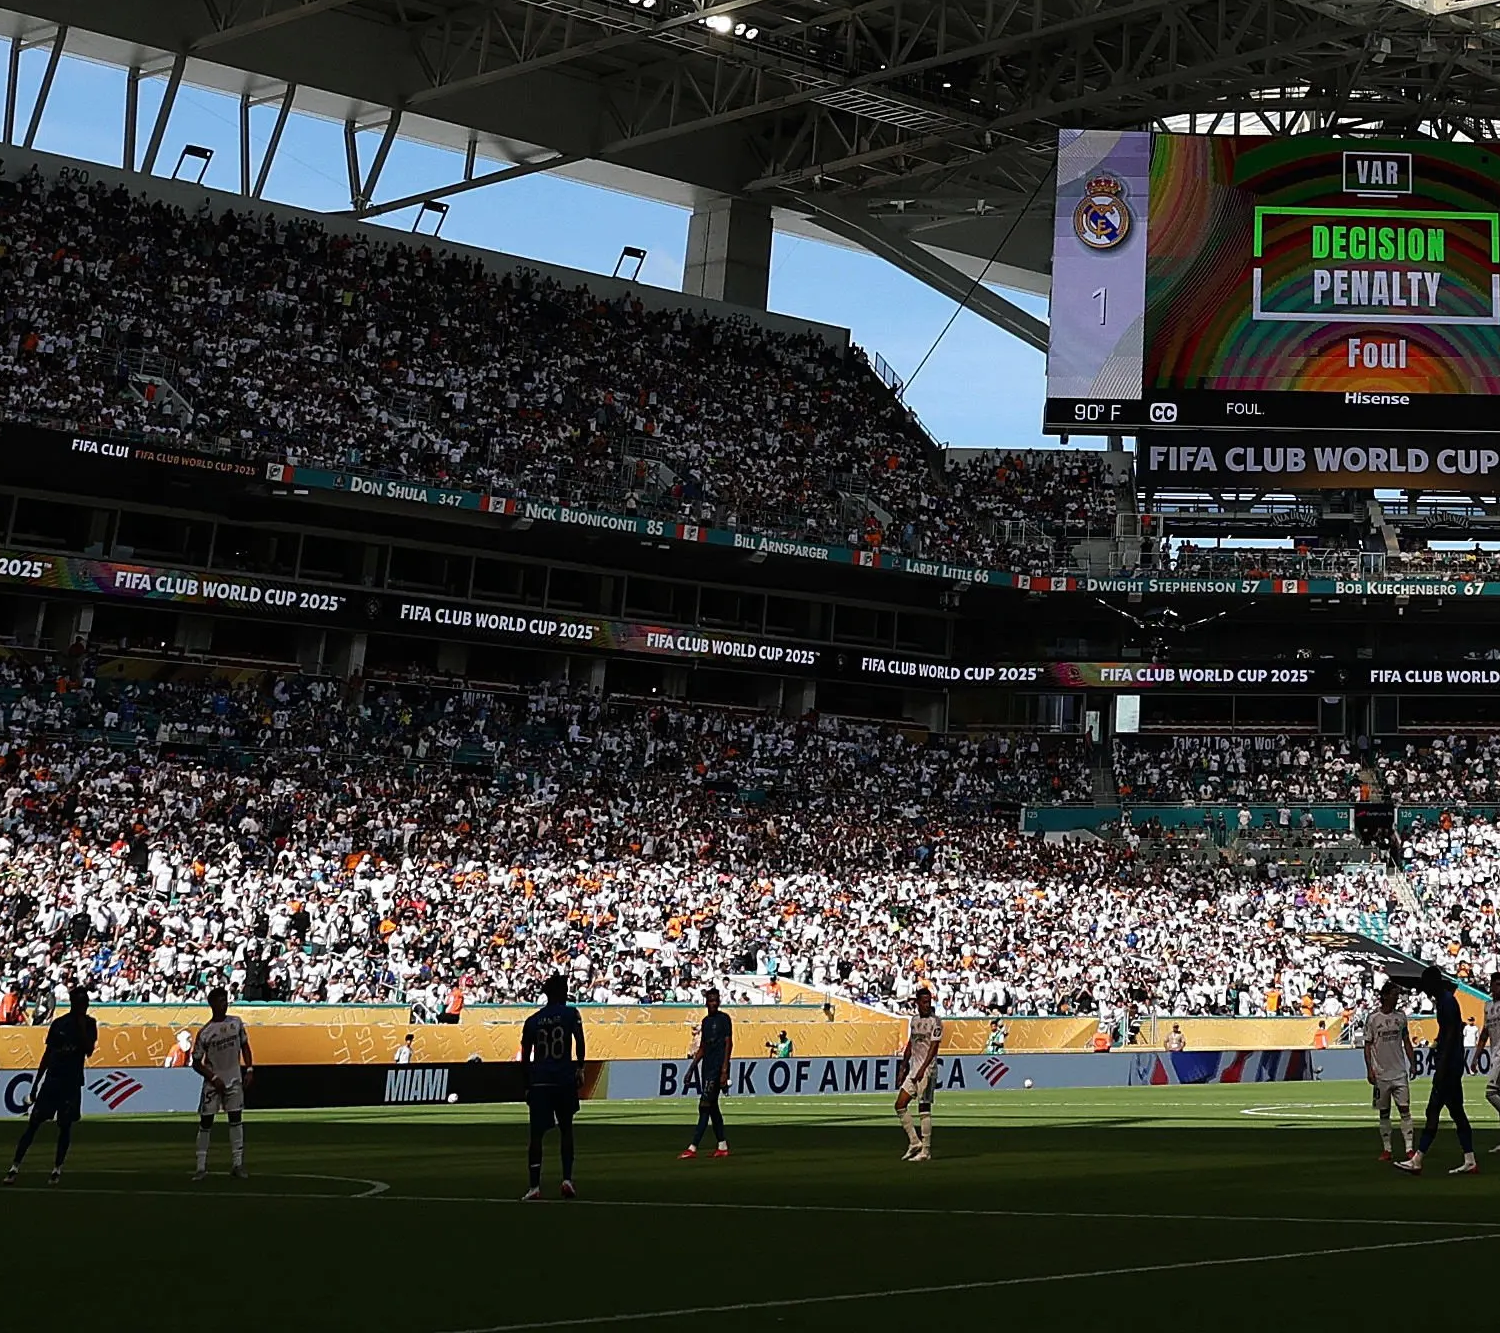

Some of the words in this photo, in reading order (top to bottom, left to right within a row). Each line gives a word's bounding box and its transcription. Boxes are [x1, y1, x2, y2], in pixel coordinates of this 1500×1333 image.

[1356, 160, 1398, 185] VAR
[1312, 225, 1445, 261] DECISION
[1313, 269, 1442, 307] PENALTY
[1092, 287, 1107, 326] 1
[1348, 338, 1406, 369] Foul
[1151, 404, 1177, 421] CC
[1226, 402, 1265, 416] FOUL.
[1345, 392, 1410, 405] Hisense
[1111, 405, 1121, 421] F
[72, 439, 97, 453] FIFA
[1150, 446, 1217, 472] FIFA
[1225, 447, 1306, 472] CLUB
[1314, 447, 1430, 473] WORLD
[1437, 448, 1499, 474] CUP
[351, 476, 382, 495] DON
[387, 481, 427, 502] SHULA
[439, 493, 462, 506] 347
[525, 503, 556, 522] NICK
[561, 507, 636, 532] BUONICONTI
[647, 519, 663, 535] 85
[734, 533, 755, 549] BILL
[758, 536, 828, 559] ARNSPARGER
[906, 558, 939, 575] LARRY
[943, 564, 972, 583] LITTLE
[974, 569, 988, 583] 66
[115, 571, 151, 590] FIFA
[156, 576, 198, 595] CLUB
[203, 581, 261, 602] WORLD
[265, 588, 296, 605] CUP
[1087, 577, 1143, 595] DWIGHT
[1150, 578, 1235, 592] STEPHENSON
[1242, 580, 1260, 592] 57
[1336, 580, 1362, 593] BOB
[1367, 581, 1456, 597] KUECHENBERG
[1464, 580, 1484, 595] 67
[401, 604, 431, 621] FIFA
[436, 608, 471, 625] CLUB
[476, 612, 526, 631] WORLD
[530, 619, 556, 635] CUP
[385, 1069, 449, 1103] MIAMI
[769, 1060, 809, 1094] OF
